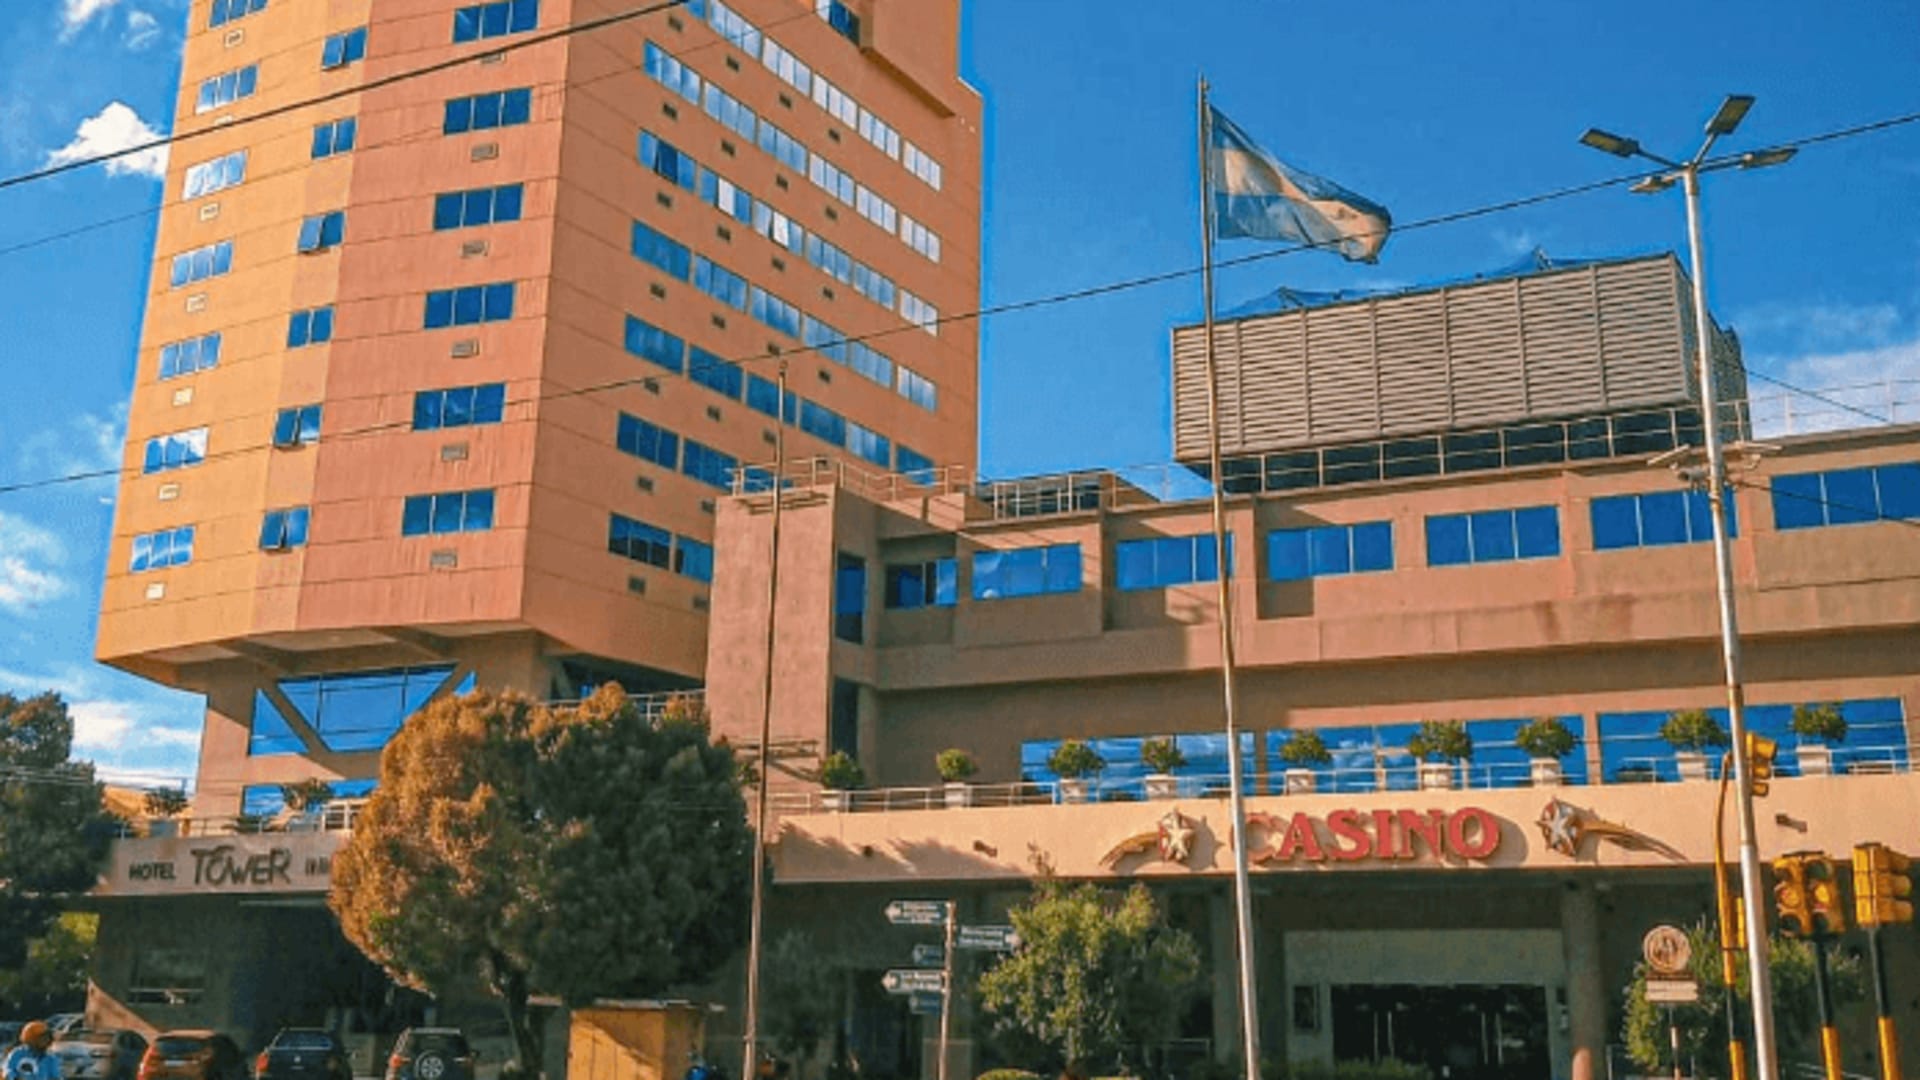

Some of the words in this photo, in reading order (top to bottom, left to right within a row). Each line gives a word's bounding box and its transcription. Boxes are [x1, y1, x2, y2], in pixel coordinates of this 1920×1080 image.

[1230, 807, 1500, 862] CASINO
[129, 862, 176, 881] HOTEL
[191, 845, 292, 886] TOWER
